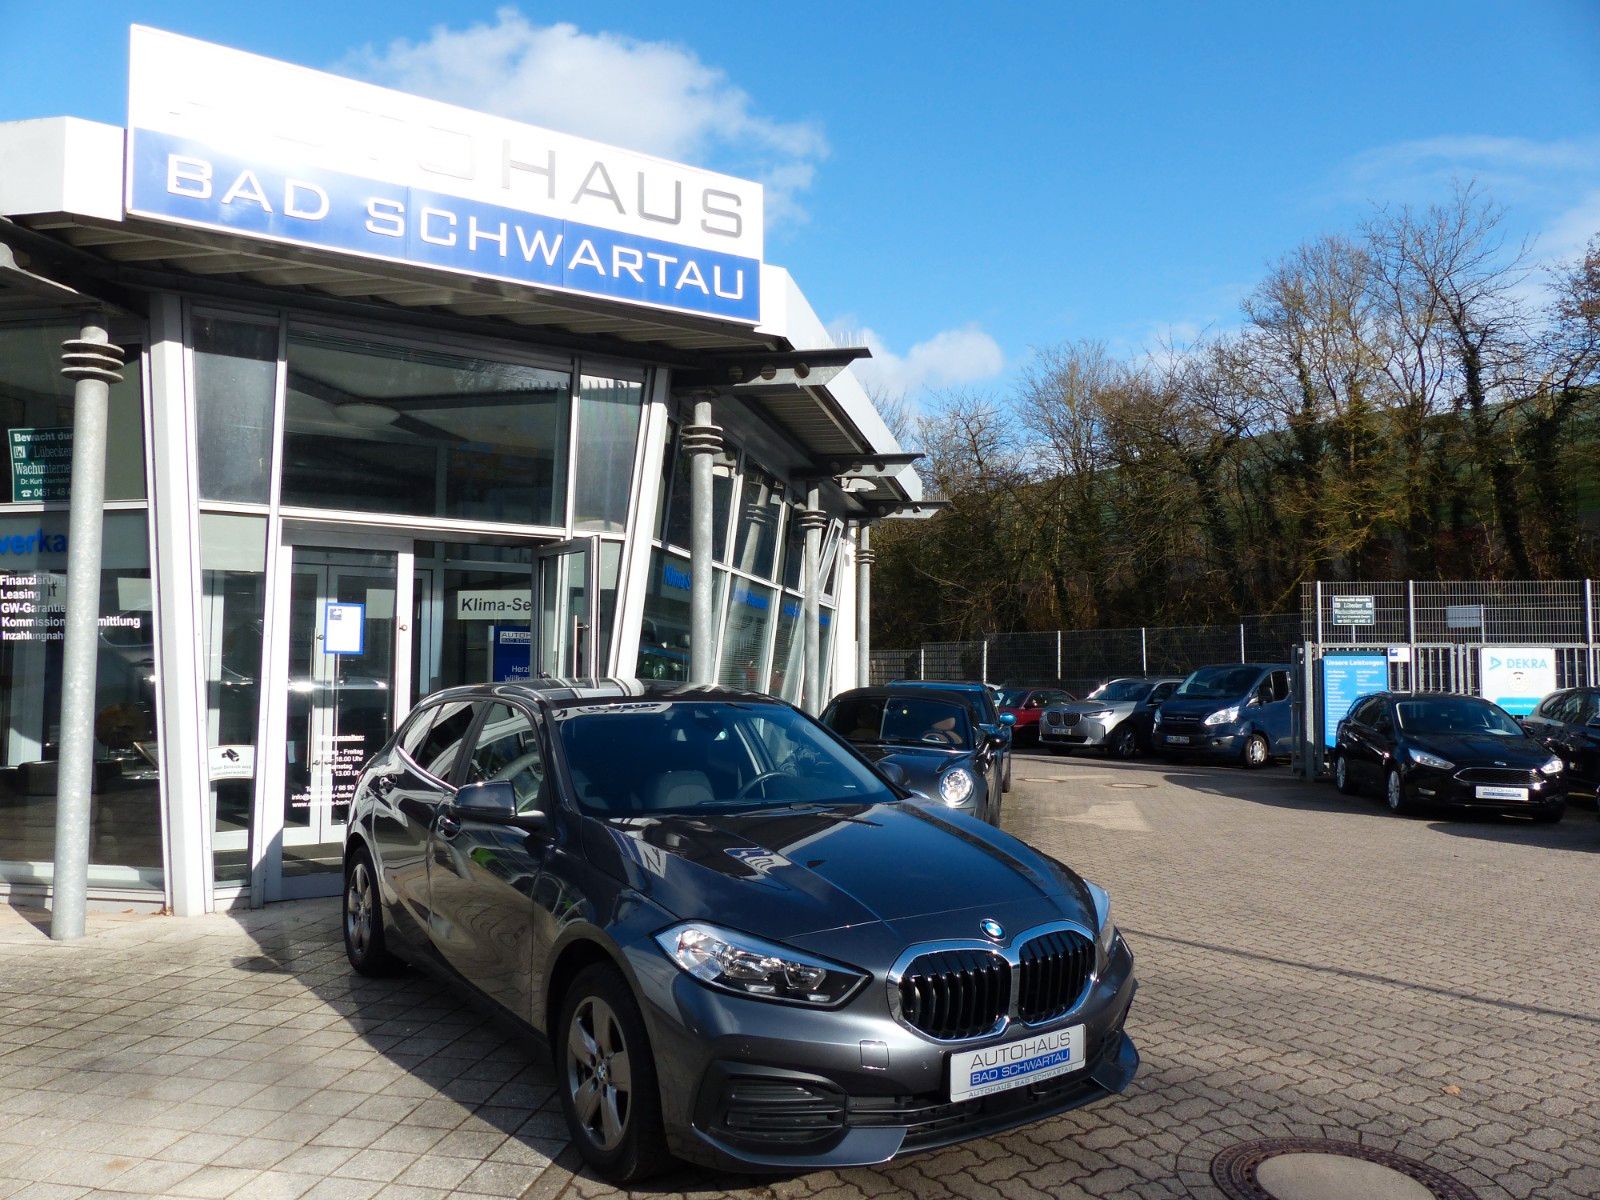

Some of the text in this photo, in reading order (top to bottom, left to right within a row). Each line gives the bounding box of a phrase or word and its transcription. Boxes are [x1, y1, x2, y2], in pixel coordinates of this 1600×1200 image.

[167, 153, 744, 300] BAD SCHWARTAU
[14, 432, 74, 442] Bewacht dur
[15, 462, 72, 475] Wachunterne
[0, 528, 67, 554] verka
[0, 588, 41, 601] Leasing
[1, 602, 66, 614] GW-Garantie
[461, 597, 531, 611] Klima-Se
[3, 630, 64, 642] Inzahlungnah
[512, 665, 530, 673] Herzl
[1506, 658, 1548, 669] DEKRA
[344, 748, 364, 756] Freitag
[970, 1031, 1071, 1069] AUTOHAUS
[972, 1051, 1069, 1085] BAD SCHWARTAU
[968, 1065, 1073, 1098] AUTOHAUS BAD SCHWARTAU
